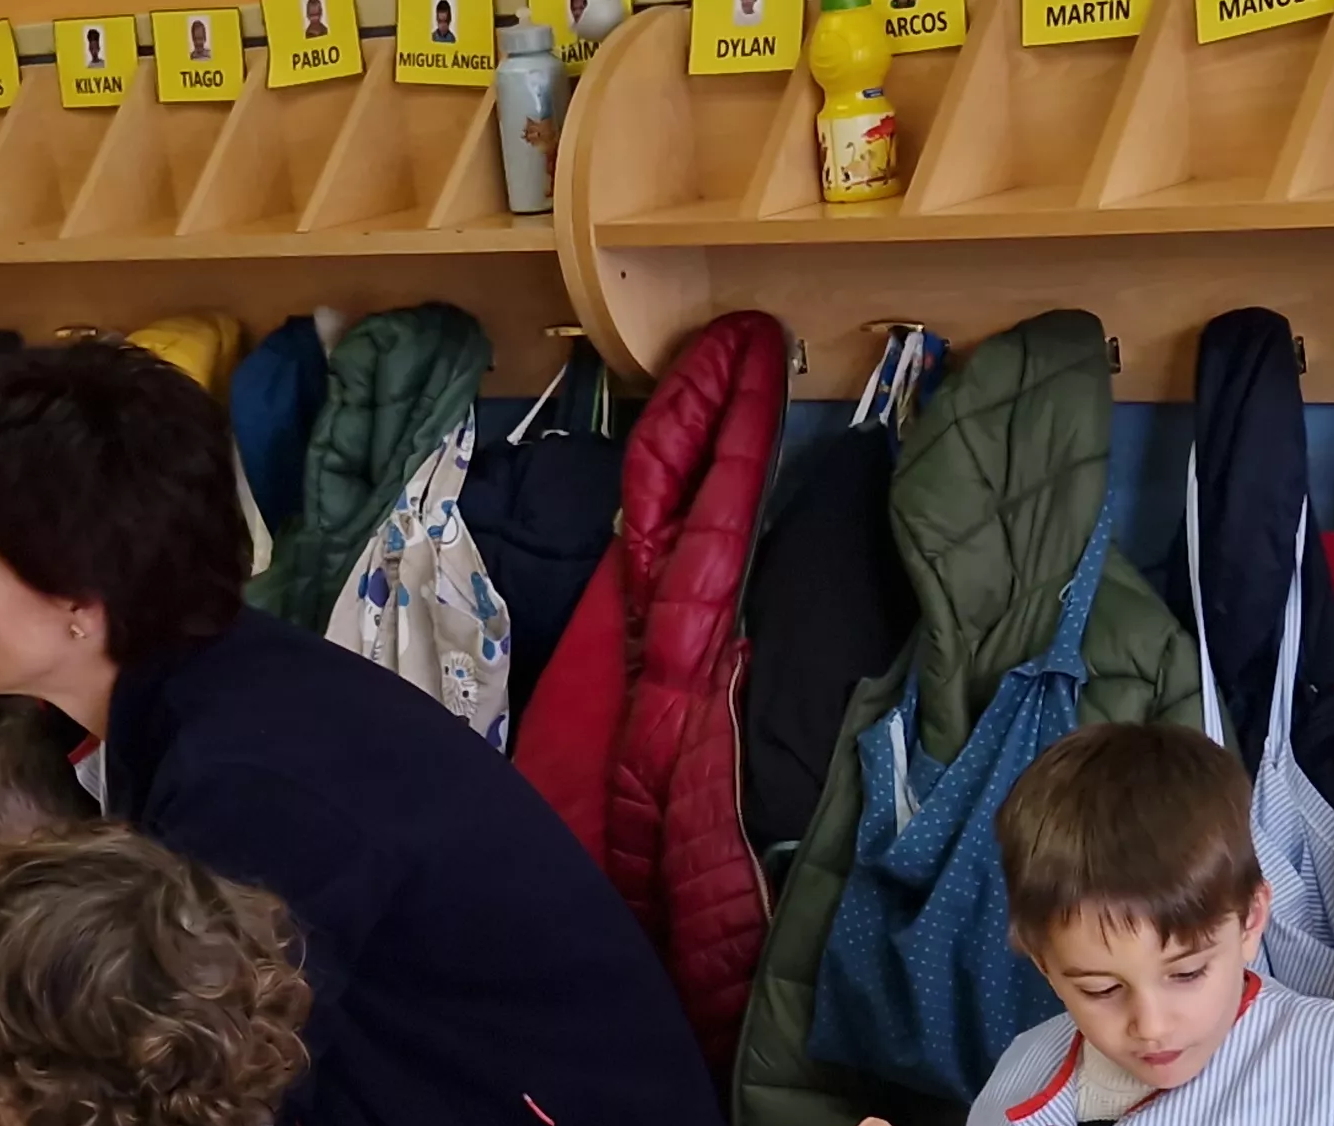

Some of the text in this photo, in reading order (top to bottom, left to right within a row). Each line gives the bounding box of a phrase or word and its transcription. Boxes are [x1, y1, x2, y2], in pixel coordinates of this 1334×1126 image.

[885, 10, 948, 38] ARCOS
[292, 45, 340, 71] PABLO
[716, 35, 776, 59] DYLAN
[399, 50, 494, 70] MIGUEL ÁNGEL
[75, 75, 123, 94] KILYAN
[180, 70, 224, 88] TIAGO
